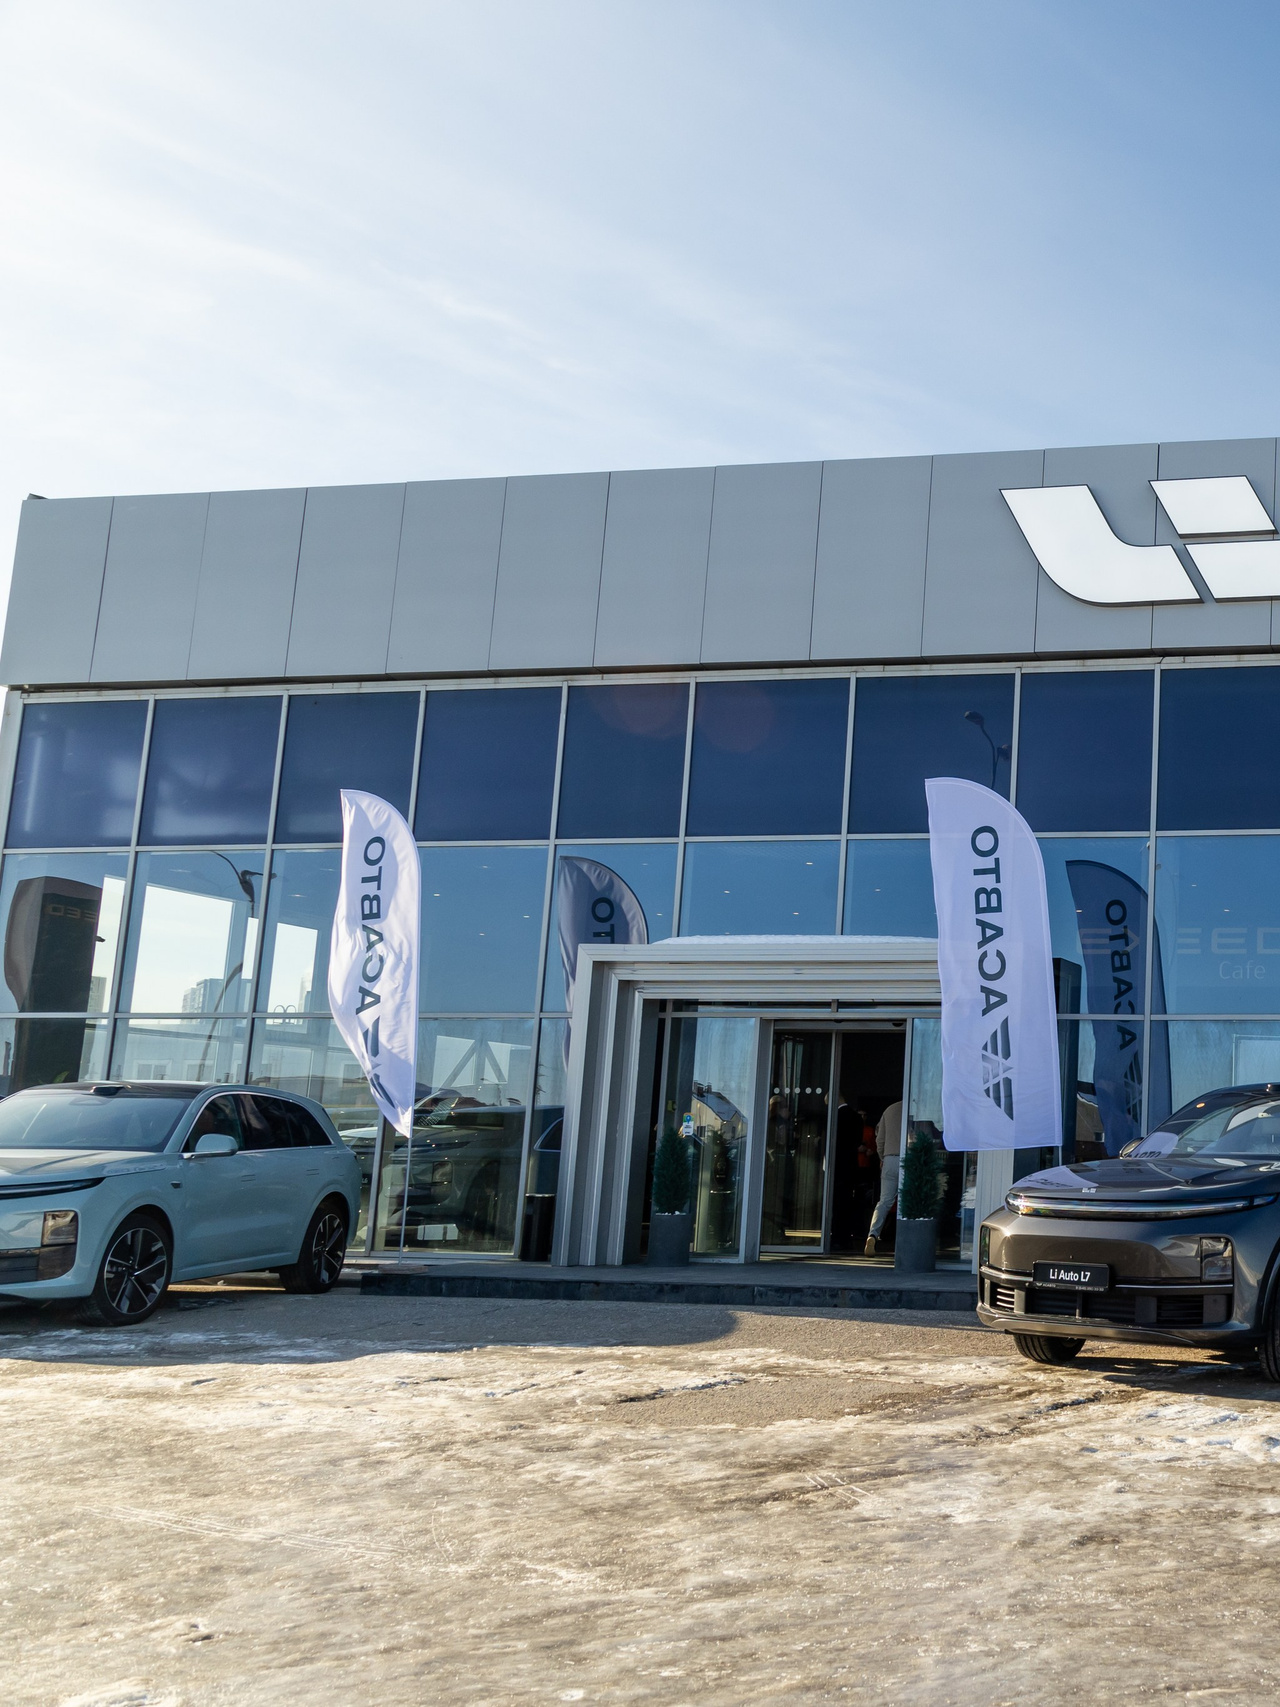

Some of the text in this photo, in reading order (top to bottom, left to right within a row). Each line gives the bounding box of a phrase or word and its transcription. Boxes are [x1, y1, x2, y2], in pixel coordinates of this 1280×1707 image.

[1219, 960, 1266, 980] Cafe
[1049, 1268, 1091, 1282] Li Auto L7
